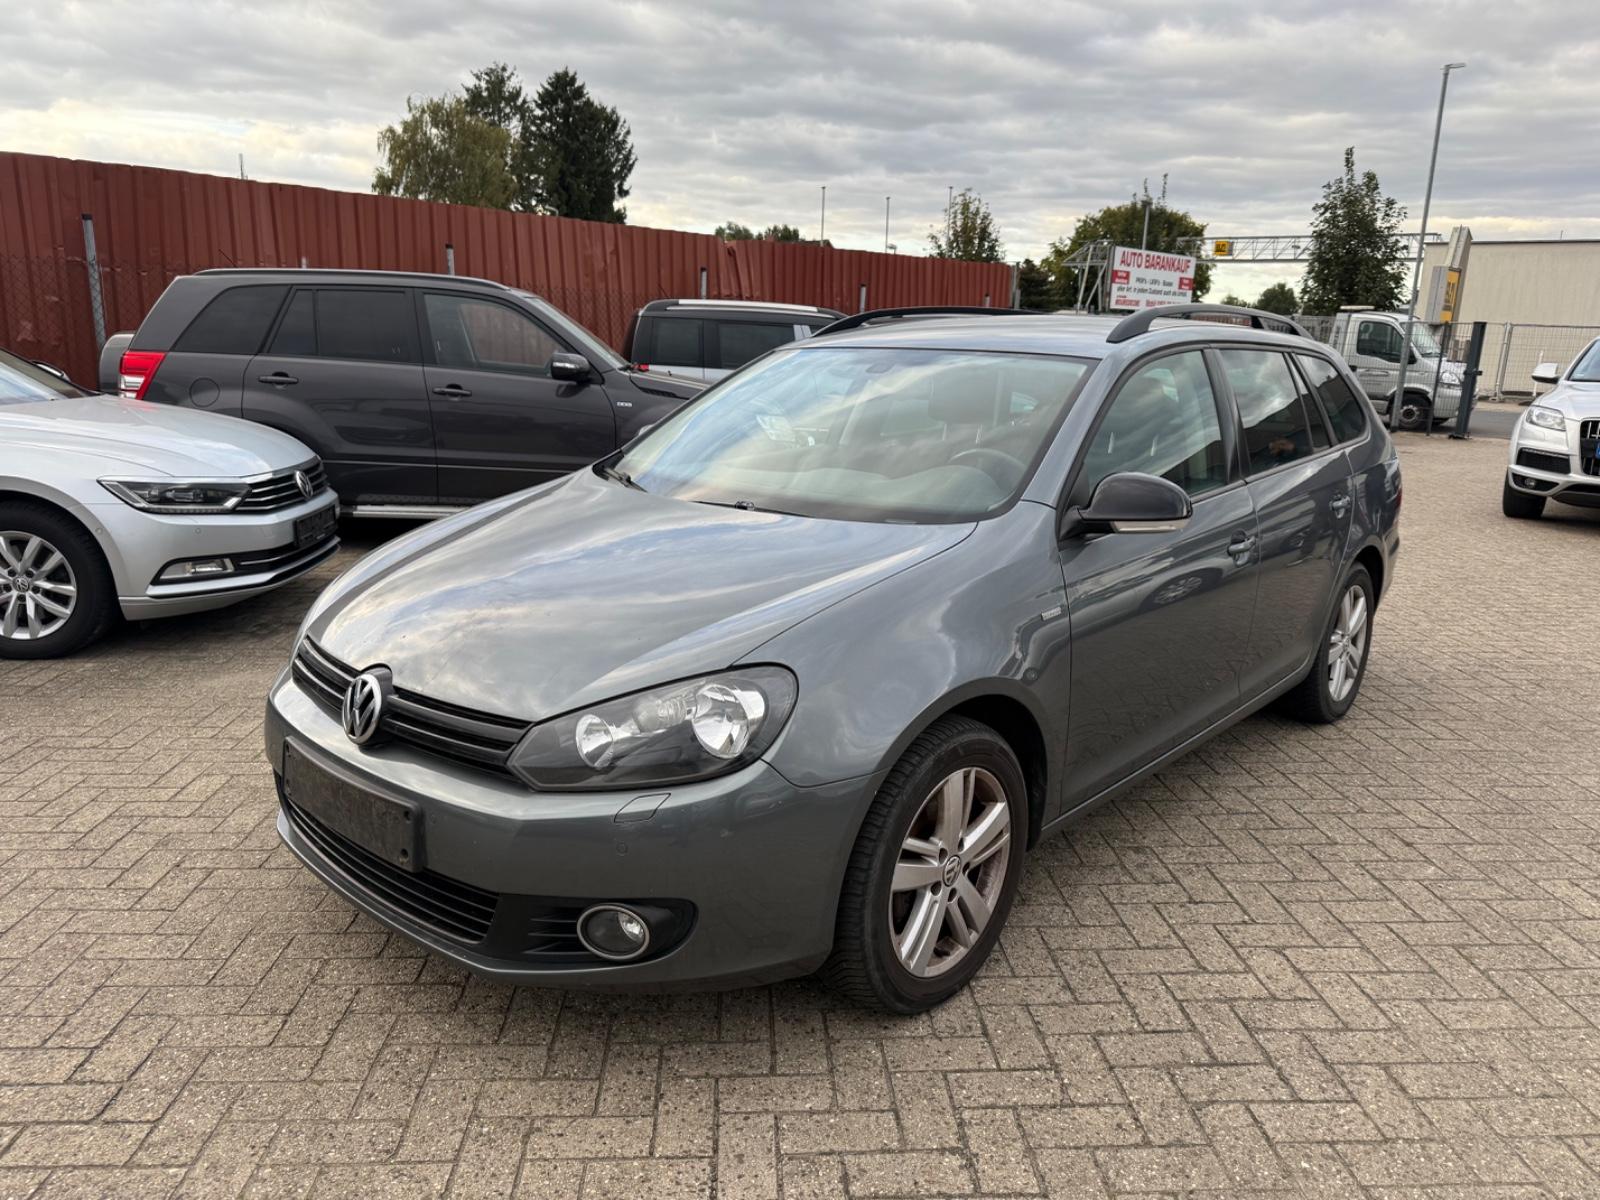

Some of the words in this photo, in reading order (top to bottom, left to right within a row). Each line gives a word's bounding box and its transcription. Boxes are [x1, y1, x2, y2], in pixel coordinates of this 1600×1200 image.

[1120, 250, 1143, 268] AUTO
[1144, 253, 1191, 273] BARANKAUF
[342, 673, 382, 745] VW
